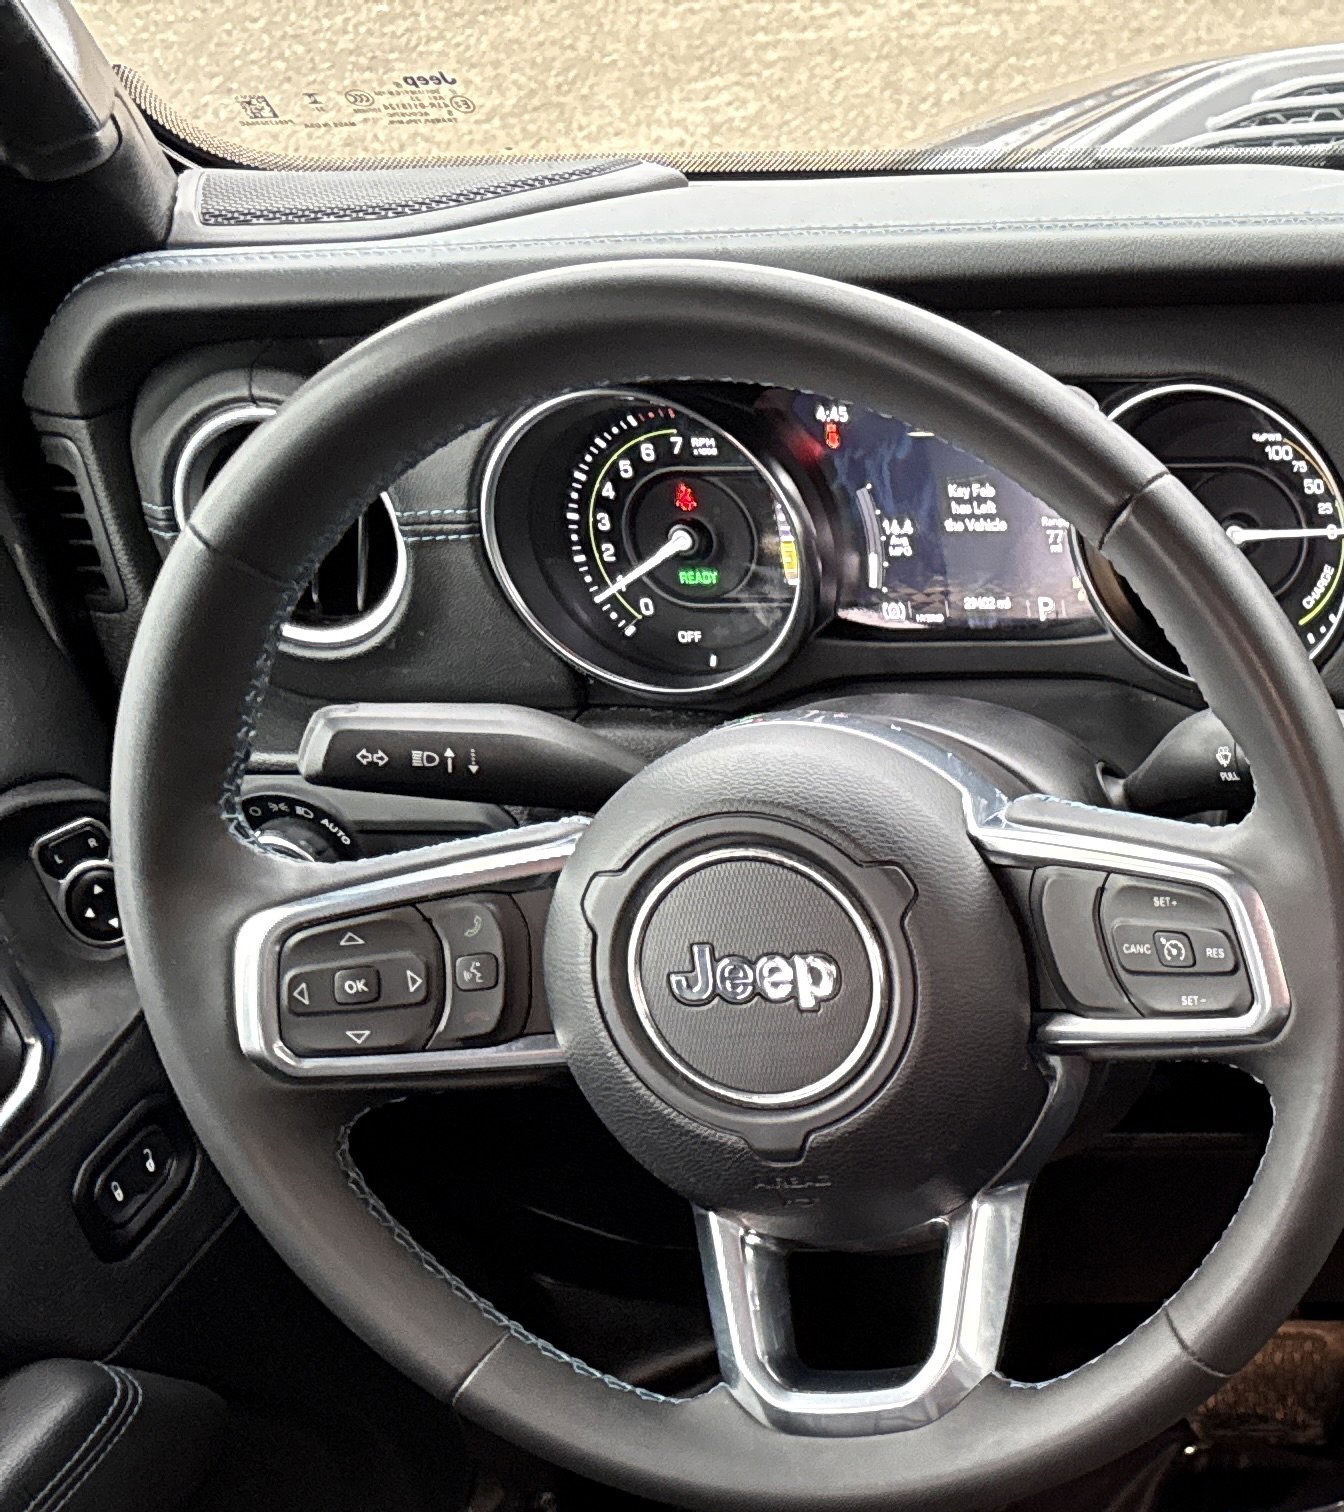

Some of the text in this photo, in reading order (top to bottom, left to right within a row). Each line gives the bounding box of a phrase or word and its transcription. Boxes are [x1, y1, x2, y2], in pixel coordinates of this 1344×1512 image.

[816, 405, 849, 422] 4:45
[670, 436, 683, 455] 7
[691, 437, 716, 448] RPM
[640, 443, 655, 462] 6
[1265, 446, 1293, 461] 100
[619, 460, 633, 479] 5
[1292, 461, 1307, 473] 75
[602, 482, 615, 500] 4
[947, 484, 970, 499] Key
[1303, 478, 1325, 495] 50
[973, 501, 997, 515] Left
[1317, 502, 1333, 515] 25
[597, 513, 611, 531] 3
[944, 518, 1008, 532] the Vehicle
[601, 544, 616, 562] 2
[678, 569, 718, 585] READY
[1302, 563, 1335, 610] CHARGE
[640, 598, 654, 616] 0
[1038, 597, 1055, 622] P
[677, 631, 702, 643] OFF
[1220, 771, 1240, 781] PULL
[320, 818, 351, 845] AUTO
[1122, 943, 1151, 954] CANC
[1206, 948, 1225, 959] RES
[668, 943, 841, 1012] Jeep
[344, 978, 369, 994] OK
